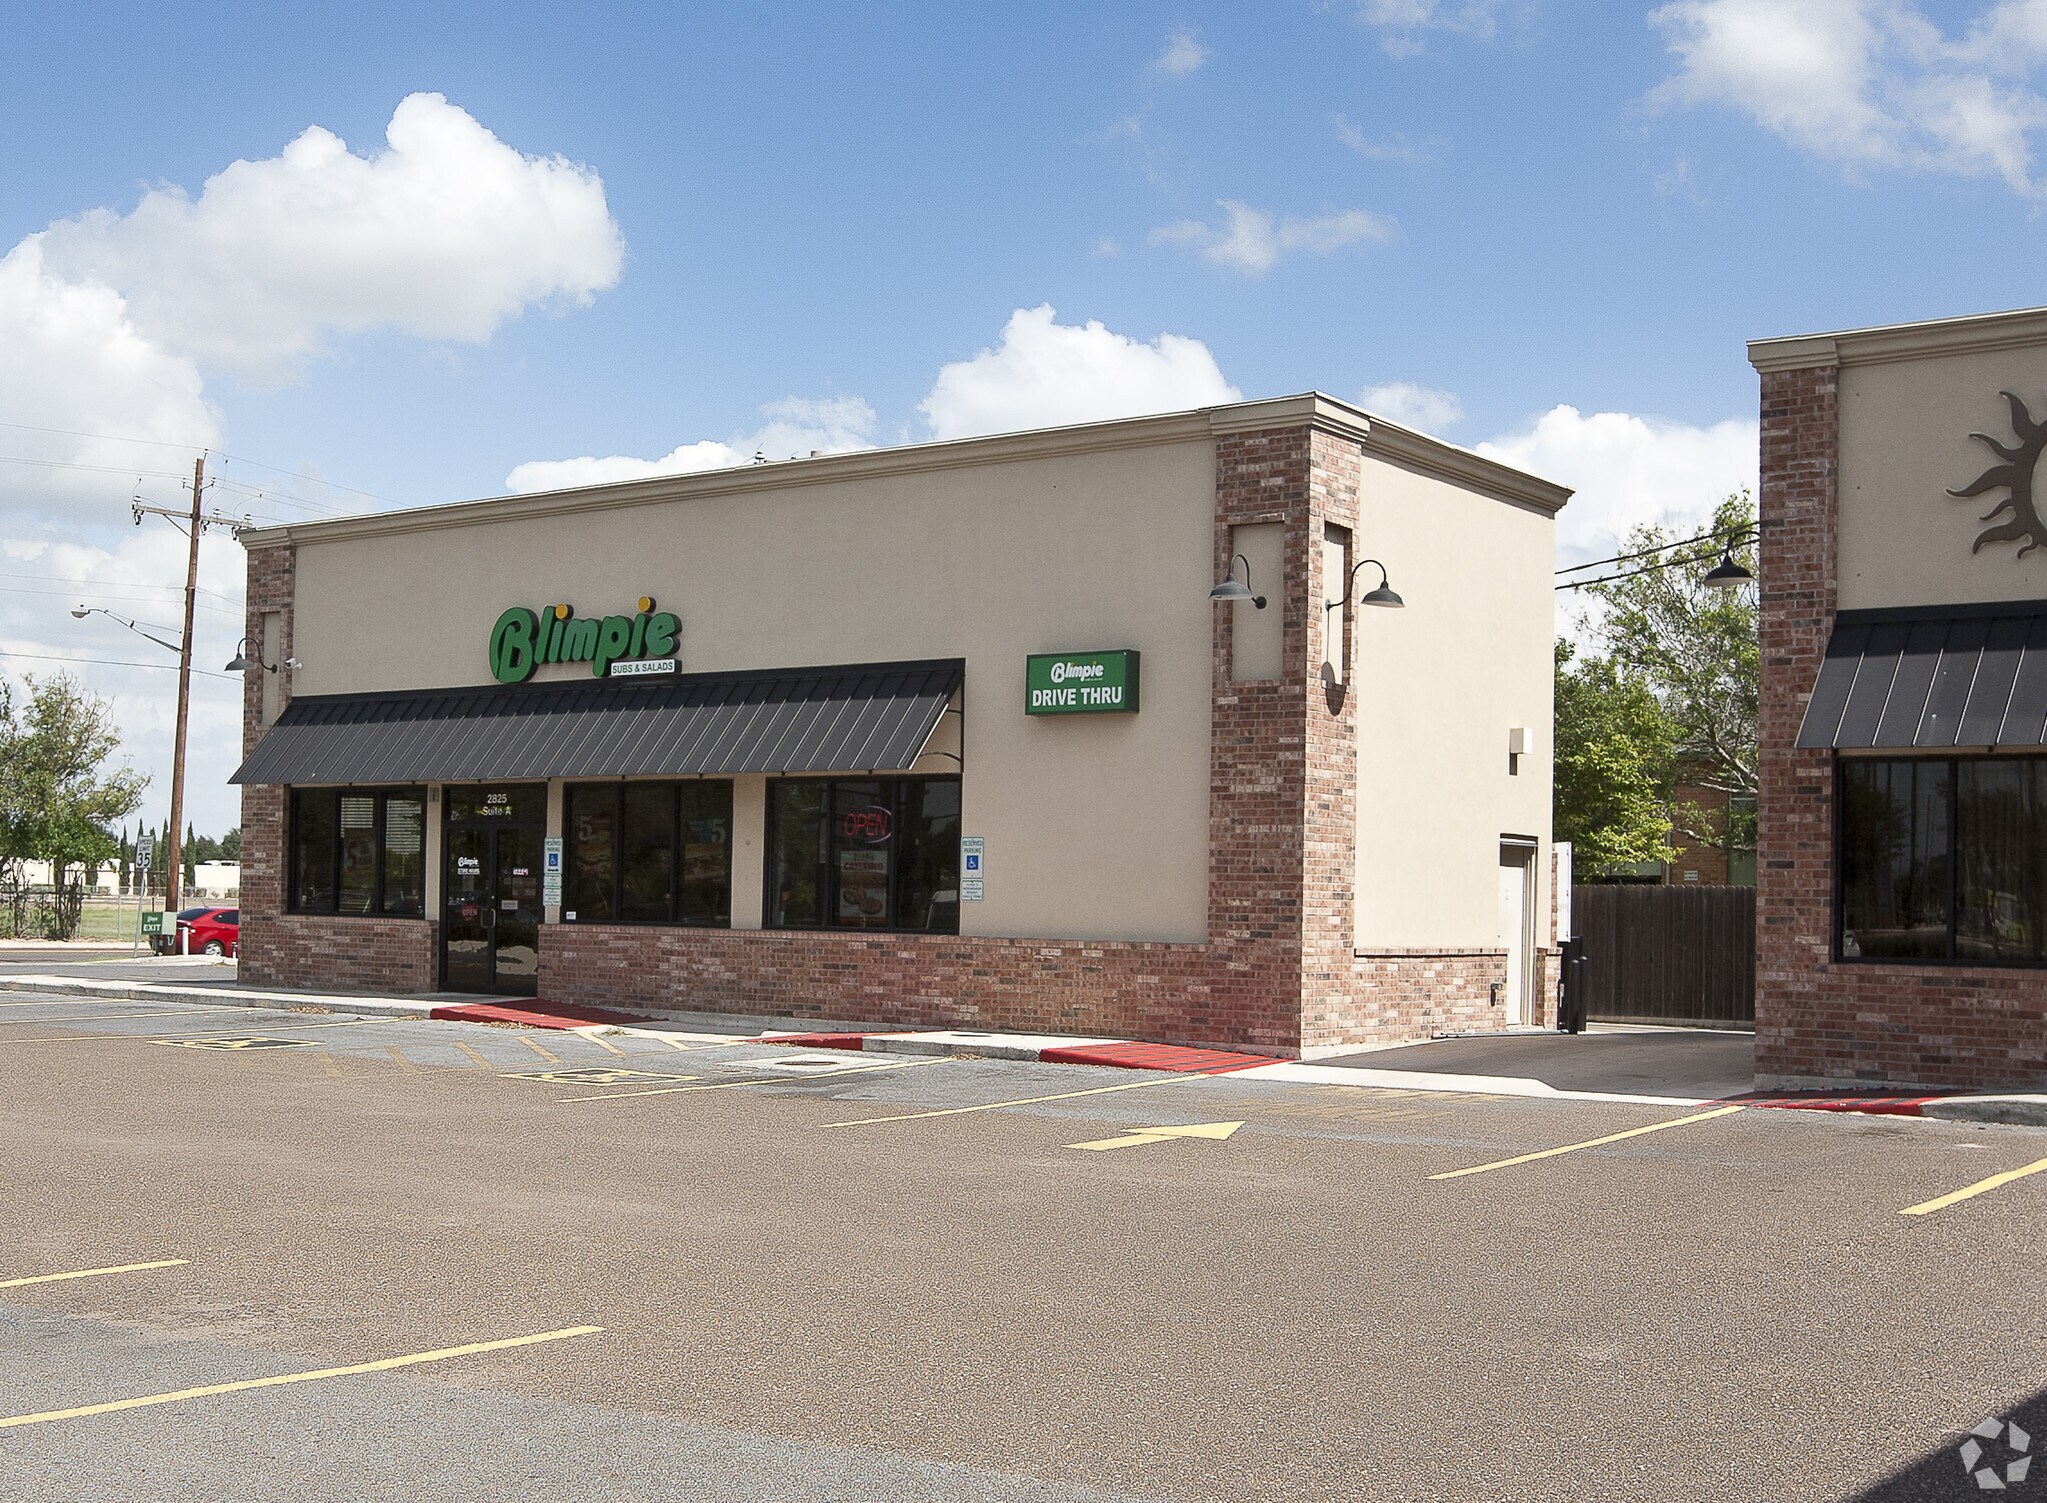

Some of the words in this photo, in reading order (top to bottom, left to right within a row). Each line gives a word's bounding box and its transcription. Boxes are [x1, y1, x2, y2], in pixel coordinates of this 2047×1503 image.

[489, 596, 681, 684] Blimpie
[612, 664, 633, 674] SUBS
[634, 663, 641, 672] &
[641, 661, 674, 672] SALADS
[1051, 661, 1104, 683] Blimpie
[1032, 688, 1077, 707] DRIVE
[1080, 686, 1122, 705] THRU
[487, 794, 507, 804] 2825
[482, 806, 503, 816] Suite
[505, 806, 512, 815] A
[845, 813, 887, 836] OPEN
[137, 852, 150, 866] 35
